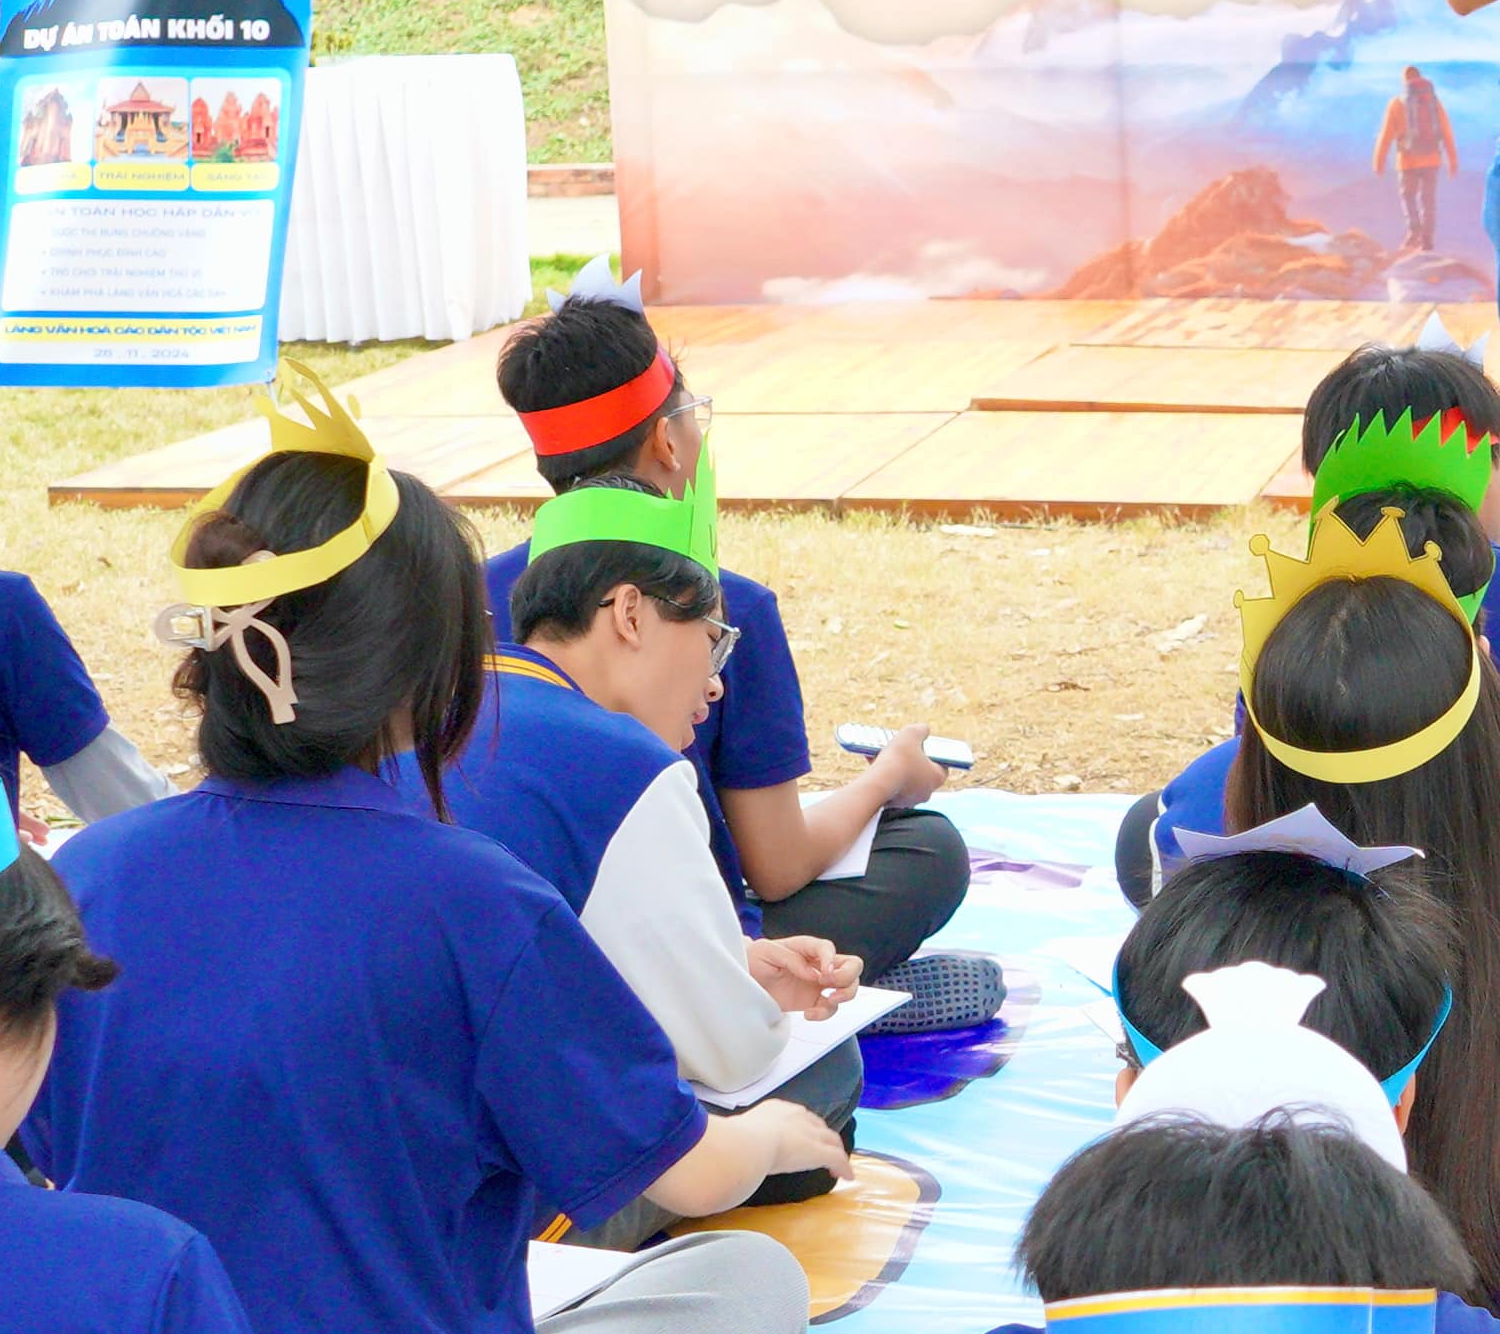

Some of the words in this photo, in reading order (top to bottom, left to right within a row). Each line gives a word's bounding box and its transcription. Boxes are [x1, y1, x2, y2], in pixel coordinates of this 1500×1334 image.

[23, 27, 59, 52] DỰ
[61, 21, 94, 47] ÁN
[97, 14, 160, 42] TOÁN
[167, 13, 234, 40] KHỐI
[239, 19, 271, 41] 10
[71, 205, 116, 218] TOÁN
[121, 206, 157, 219] HỌC
[152, 348, 190, 359] 2024
